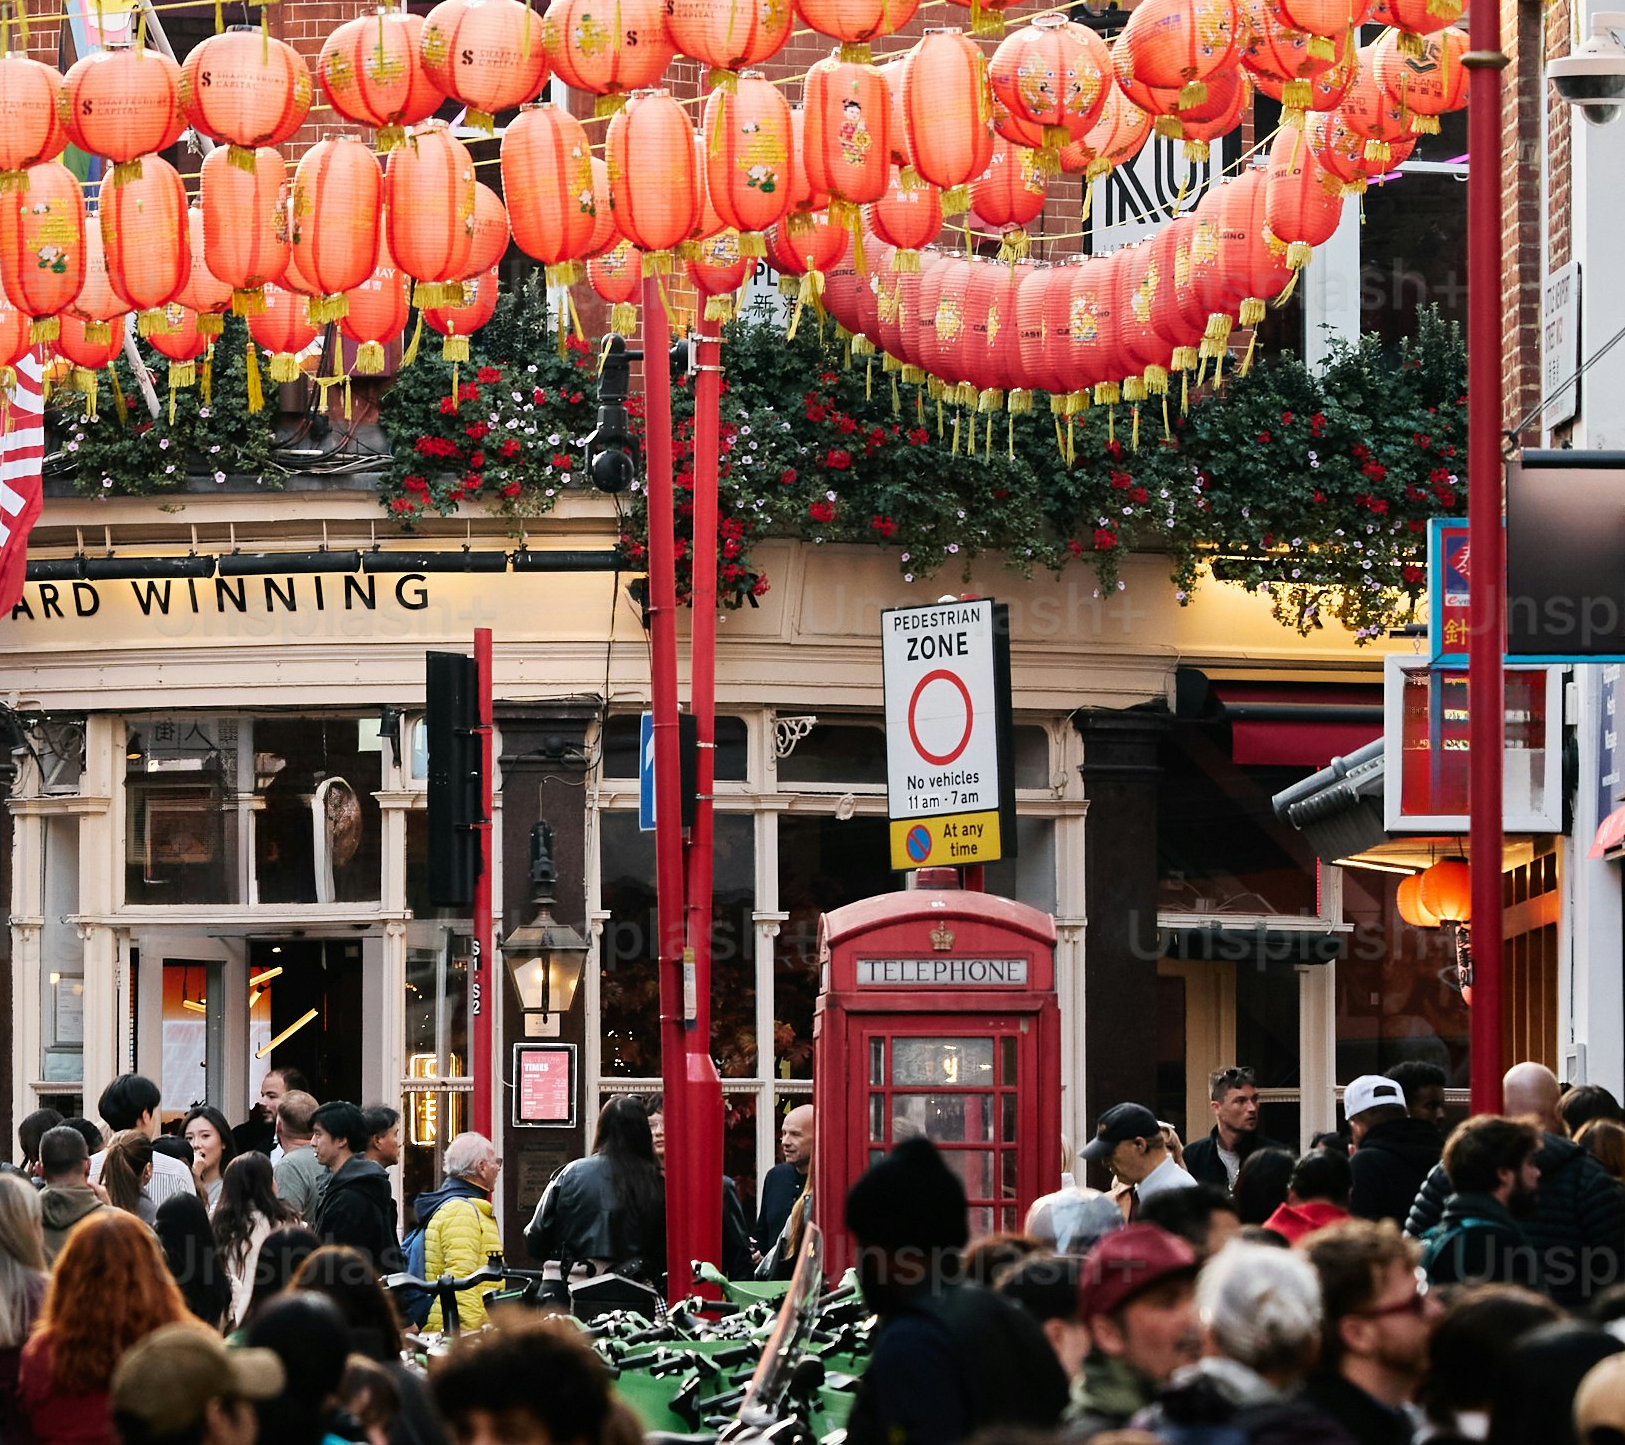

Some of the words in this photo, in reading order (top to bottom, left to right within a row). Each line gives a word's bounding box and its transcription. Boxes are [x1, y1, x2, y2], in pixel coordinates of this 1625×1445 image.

[132, 574, 430, 616] WINNING
[893, 608, 981, 632] PEDESTRIAN
[907, 632, 969, 661] ZONE
[907, 775, 925, 791] No
[929, 770, 980, 787] vehicles
[943, 823, 958, 839] At
[962, 822, 984, 839] any
[950, 840, 978, 857] time
[864, 960, 1021, 982] TELEPHONE
[524, 1062, 549, 1072] TIMES
